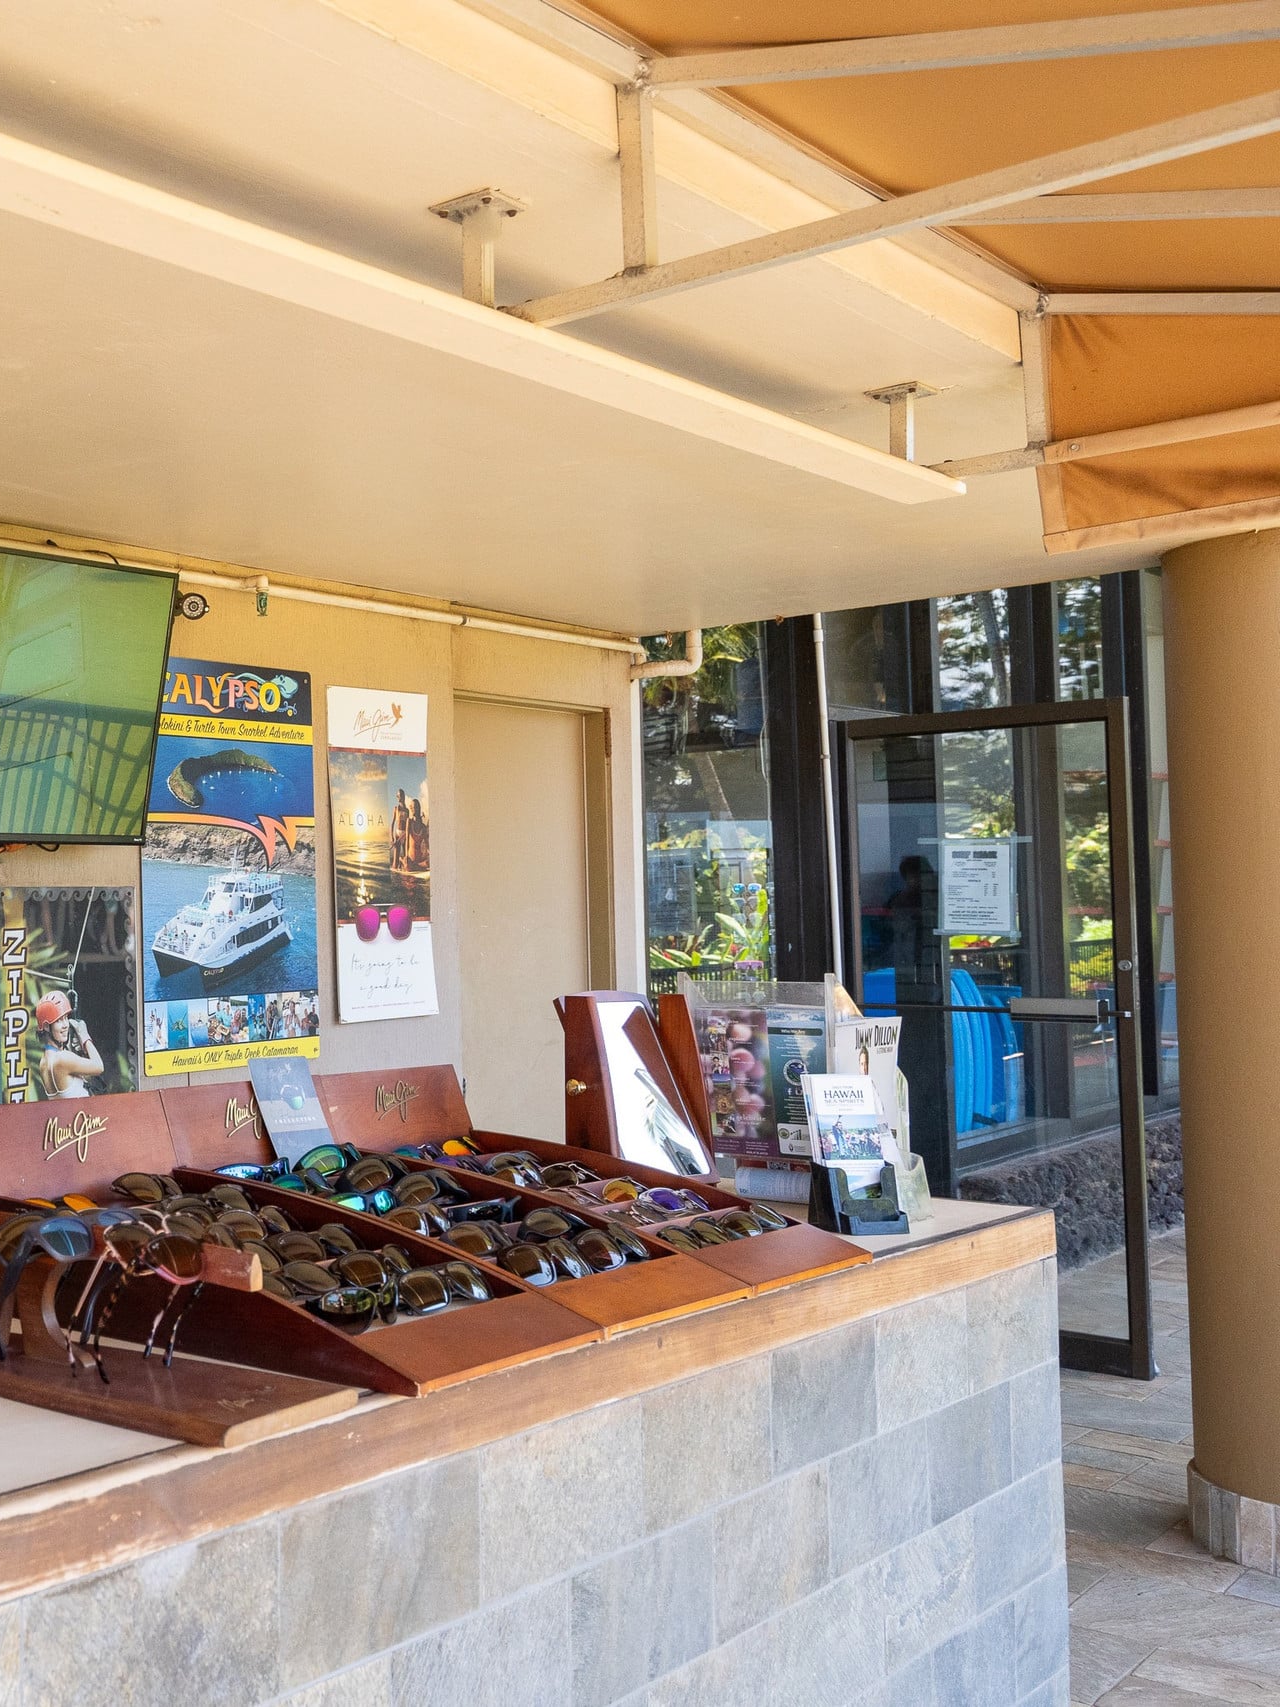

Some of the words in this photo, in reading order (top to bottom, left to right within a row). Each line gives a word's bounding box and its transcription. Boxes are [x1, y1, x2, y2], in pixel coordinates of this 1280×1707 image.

[186, 722, 192, 732] &
[194, 720, 215, 734] Turtle
[217, 721, 236, 736] Town
[238, 723, 267, 737] Snorkel
[269, 726, 304, 740] Adventure
[353, 709, 371, 731] Maui
[370, 709, 393, 743] Jim
[339, 813, 384, 826] ALOHA
[367, 961, 392, 976] going
[368, 977, 389, 1000] good
[395, 976, 414, 994] day
[855, 1028, 872, 1049] JIMMY
[874, 1025, 898, 1047] DILLON
[172, 1053, 202, 1066] Hawaii's
[204, 1051, 222, 1064] ONLY
[224, 1050, 243, 1061] Triple
[244, 1047, 261, 1059] Deck
[262, 1046, 298, 1057] Catamaran
[375, 1086, 396, 1112] Maui
[395, 1080, 420, 1123] Jim
[824, 1090, 863, 1098] HAWAII
[225, 1097, 250, 1129] Maui
[43, 1115, 74, 1152] Maui
[74, 1110, 109, 1163] Jim
